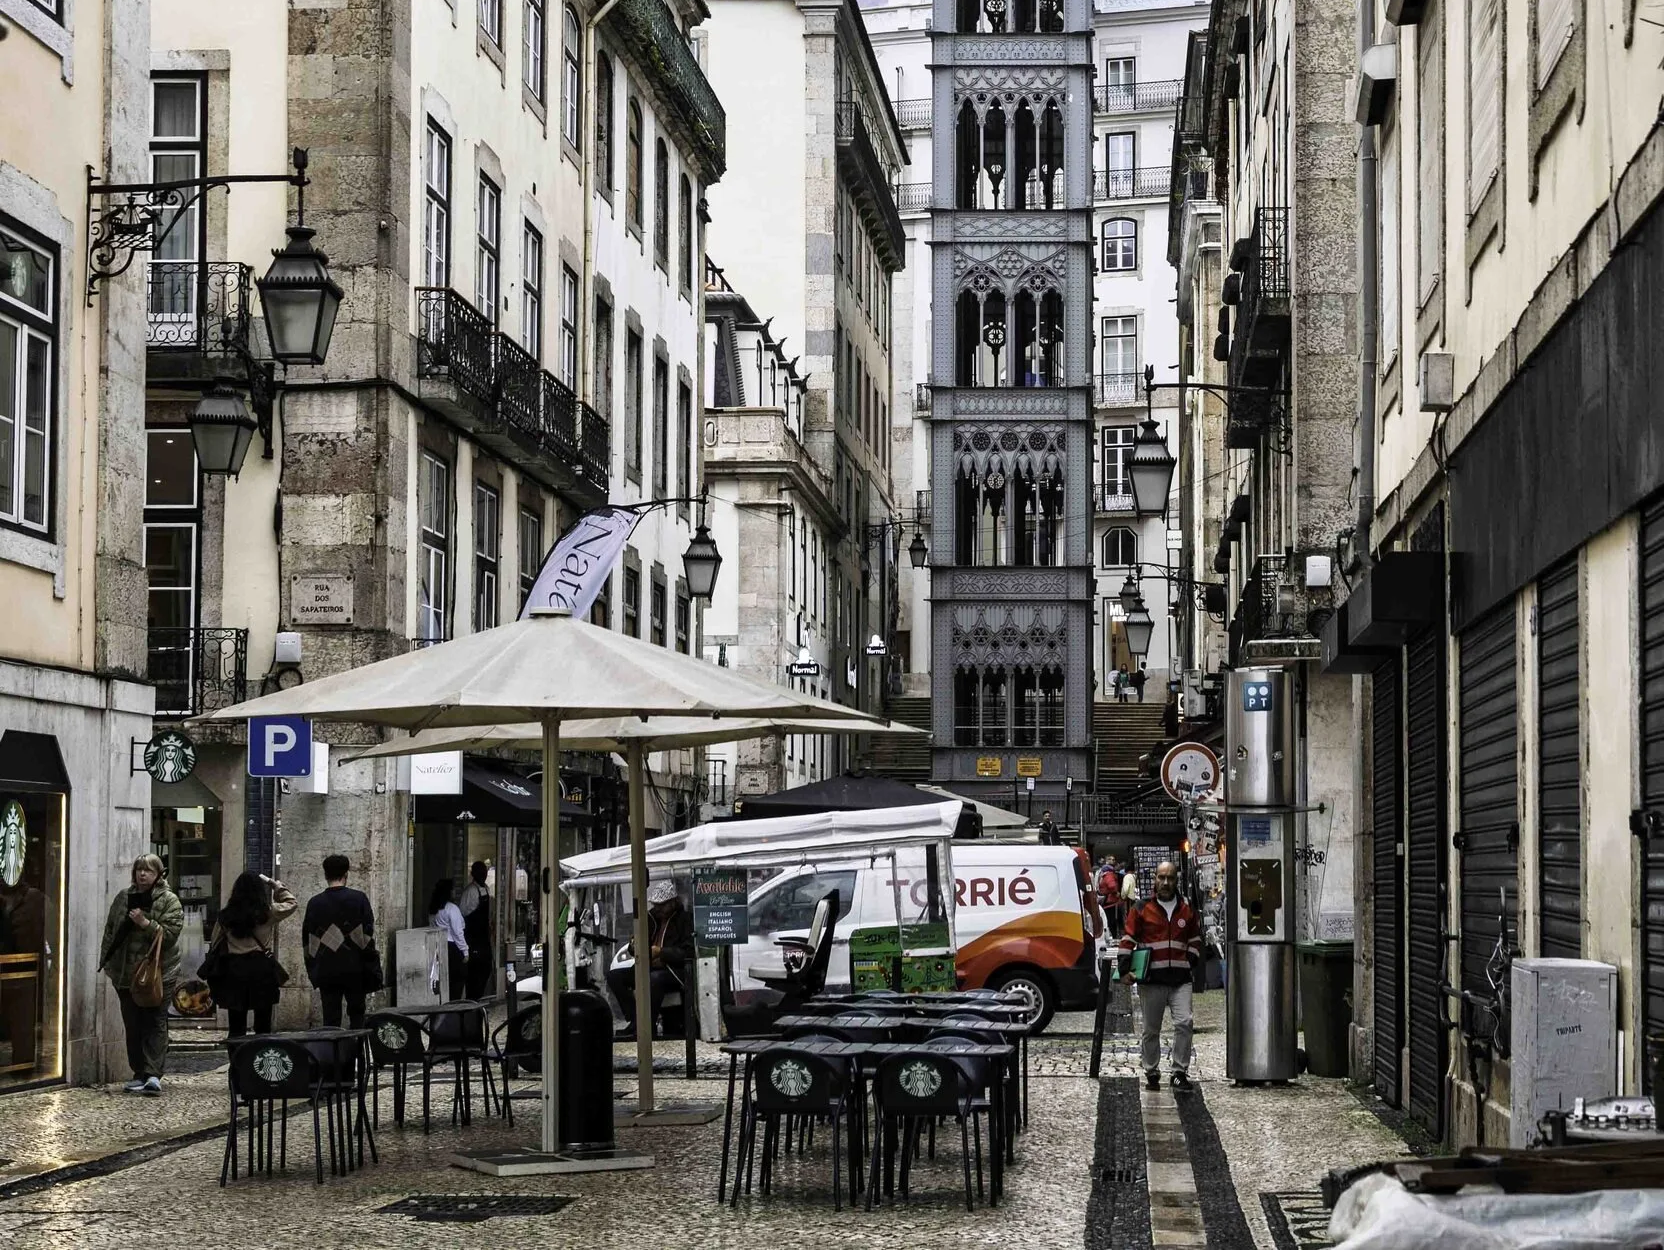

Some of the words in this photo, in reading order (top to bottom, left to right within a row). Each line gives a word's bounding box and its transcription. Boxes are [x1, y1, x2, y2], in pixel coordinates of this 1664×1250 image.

[314, 584, 330, 592] RUA
[866, 647, 886, 655] Normal
[792, 665, 817, 674] Normal
[264, 724, 297, 767] P
[695, 877, 746, 895] Available
[708, 924, 733, 932] ESPAÑOL
